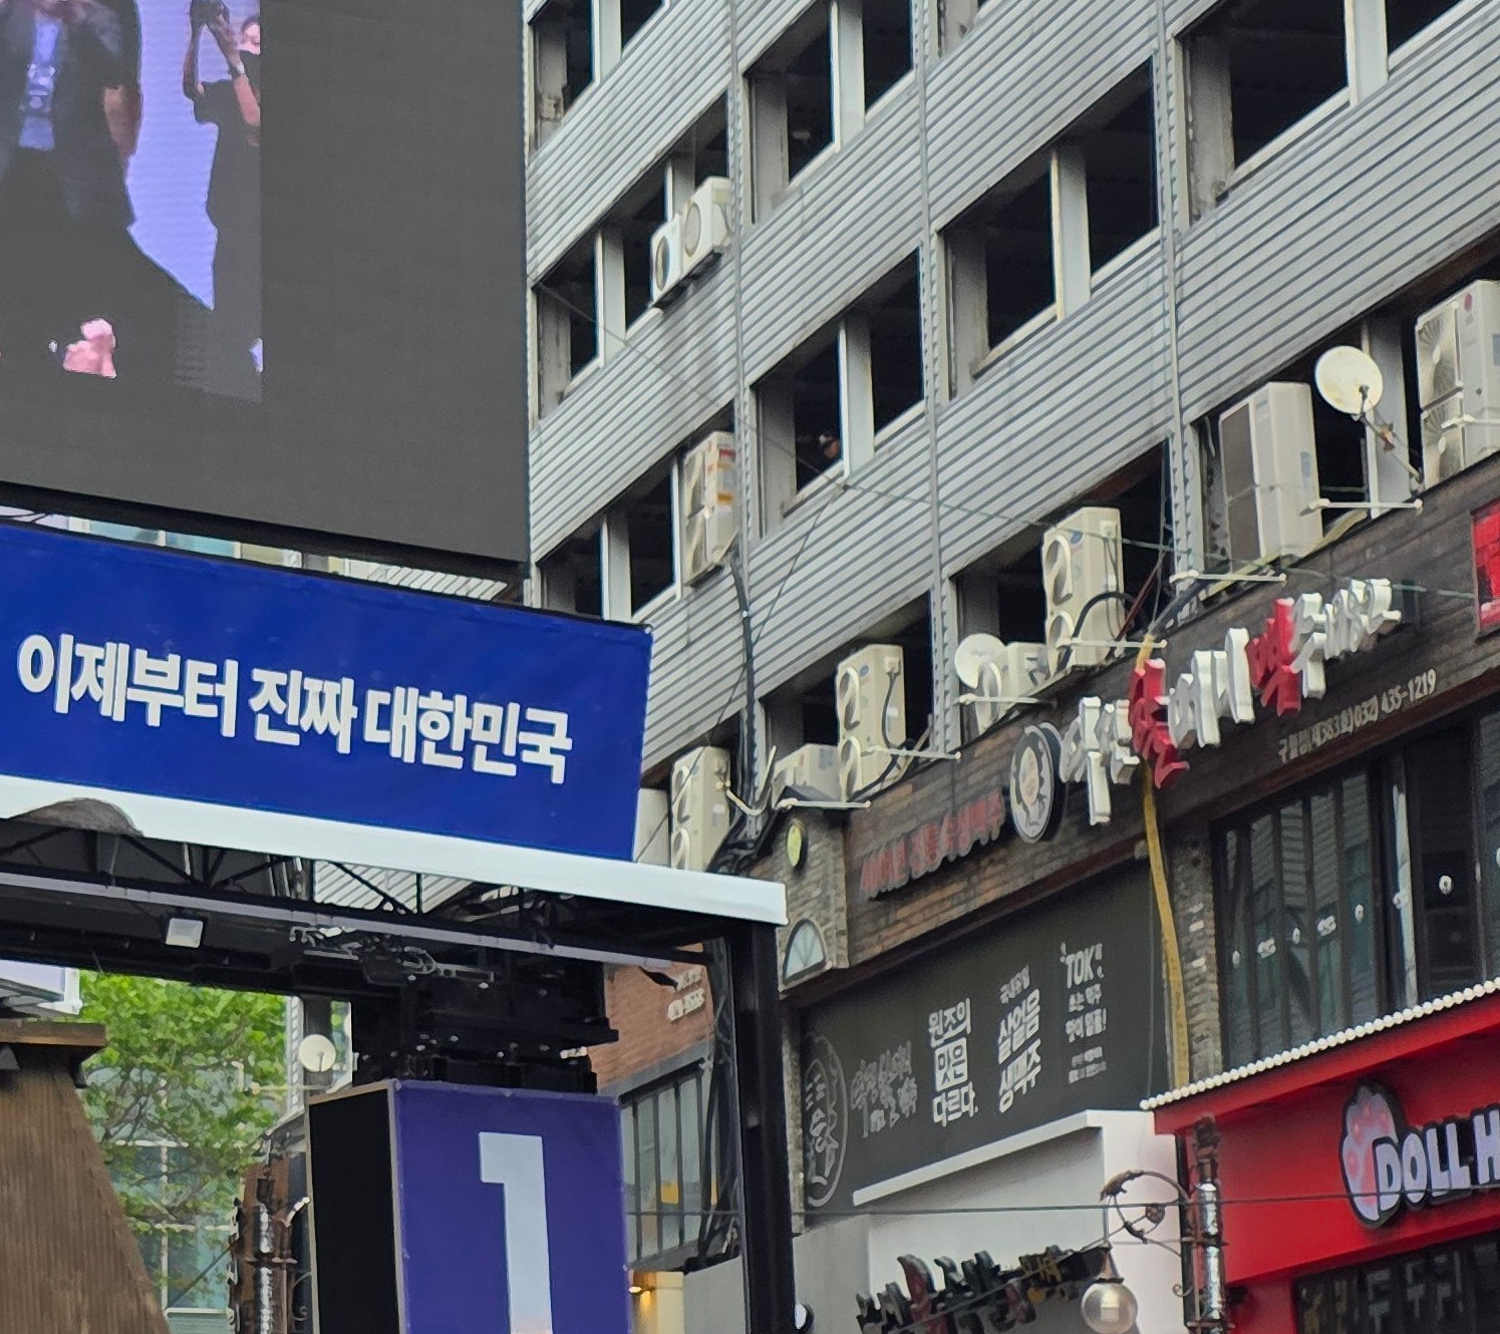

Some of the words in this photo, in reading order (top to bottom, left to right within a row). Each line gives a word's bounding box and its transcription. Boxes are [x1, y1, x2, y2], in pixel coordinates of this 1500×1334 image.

[16, 632, 239, 738] 이제부터
[249, 668, 358, 755] 진짜
[364, 687, 573, 785] 대한민국
[928, 998, 971, 1047] 원조의
[998, 988, 1041, 1065] 살얼음
[937, 1044, 966, 1087] 맛은
[1375, 1122, 1471, 1211] DOLL
